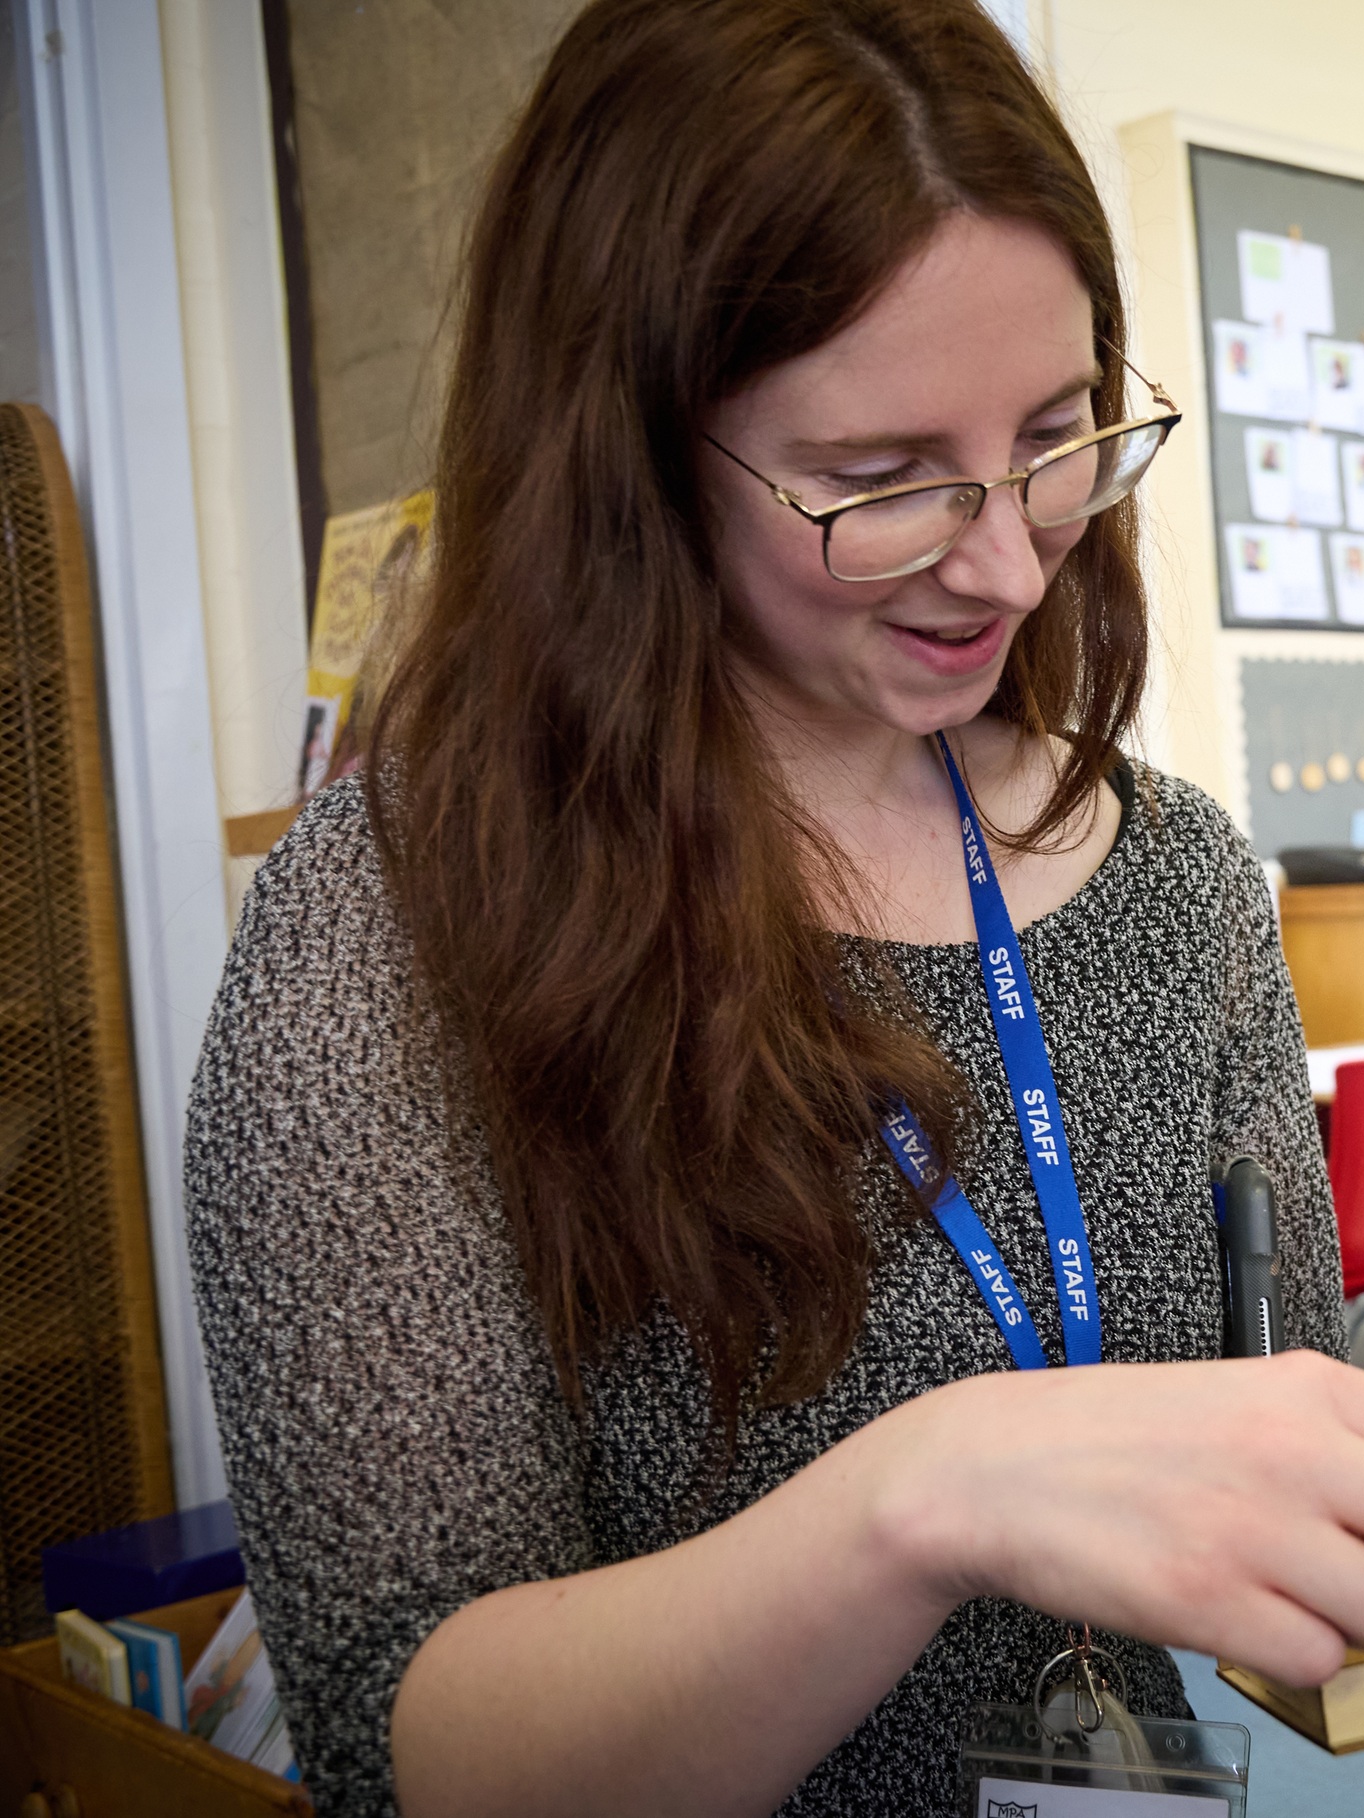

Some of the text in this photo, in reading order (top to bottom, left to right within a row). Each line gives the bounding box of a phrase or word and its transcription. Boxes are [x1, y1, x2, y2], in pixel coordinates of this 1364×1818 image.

[961, 816, 987, 884] STAFF
[988, 947, 1025, 1020] STAFF
[1023, 1088, 1059, 1166] STAFF
[971, 1249, 1023, 1326] STAFF
[1058, 1238, 1089, 1321] STAFF
[997, 1806, 1026, 1818] MPA
